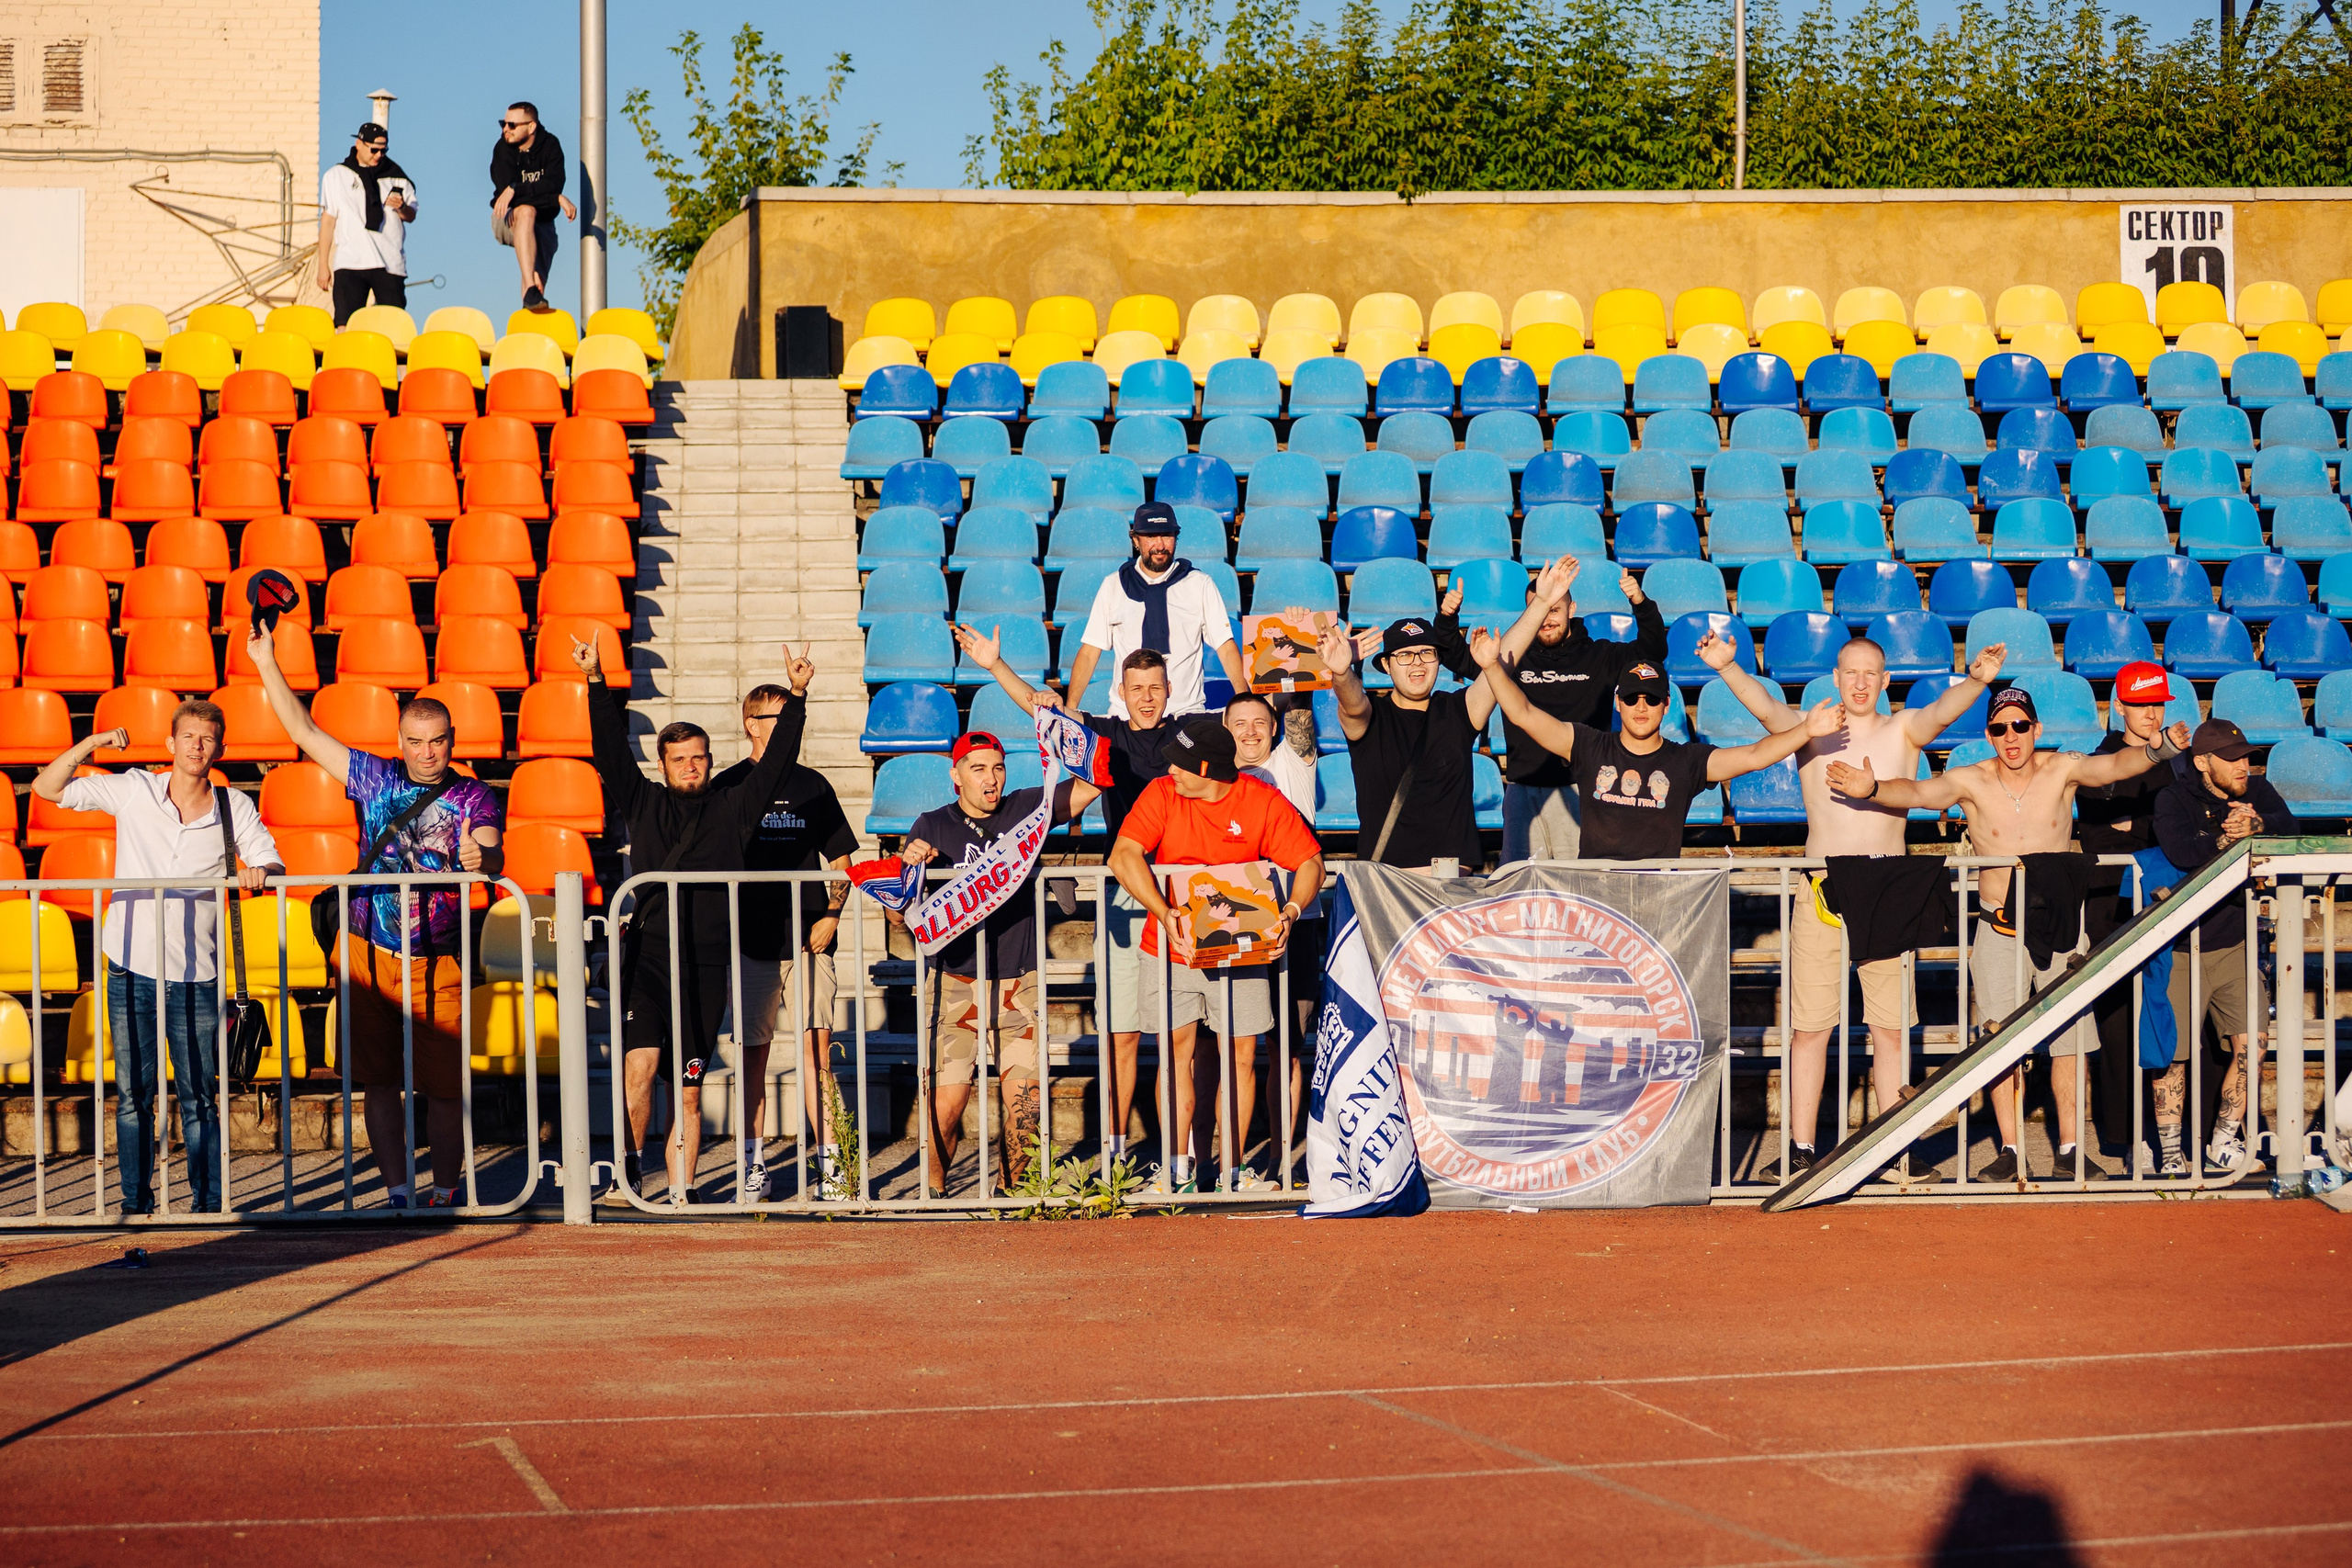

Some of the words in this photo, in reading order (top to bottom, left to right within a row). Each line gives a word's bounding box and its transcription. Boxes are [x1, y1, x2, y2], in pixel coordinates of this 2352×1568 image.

[2128, 210, 2223, 241] СЕКТОР
[2145, 246, 2225, 303] 10
[760, 818, 806, 829] emain
[921, 847, 1006, 918] FOOTBALL
[1658, 1045, 1698, 1076] 32
[1574, 1123, 1641, 1179] КЛУБ
[2218, 1152, 2232, 1167] N
